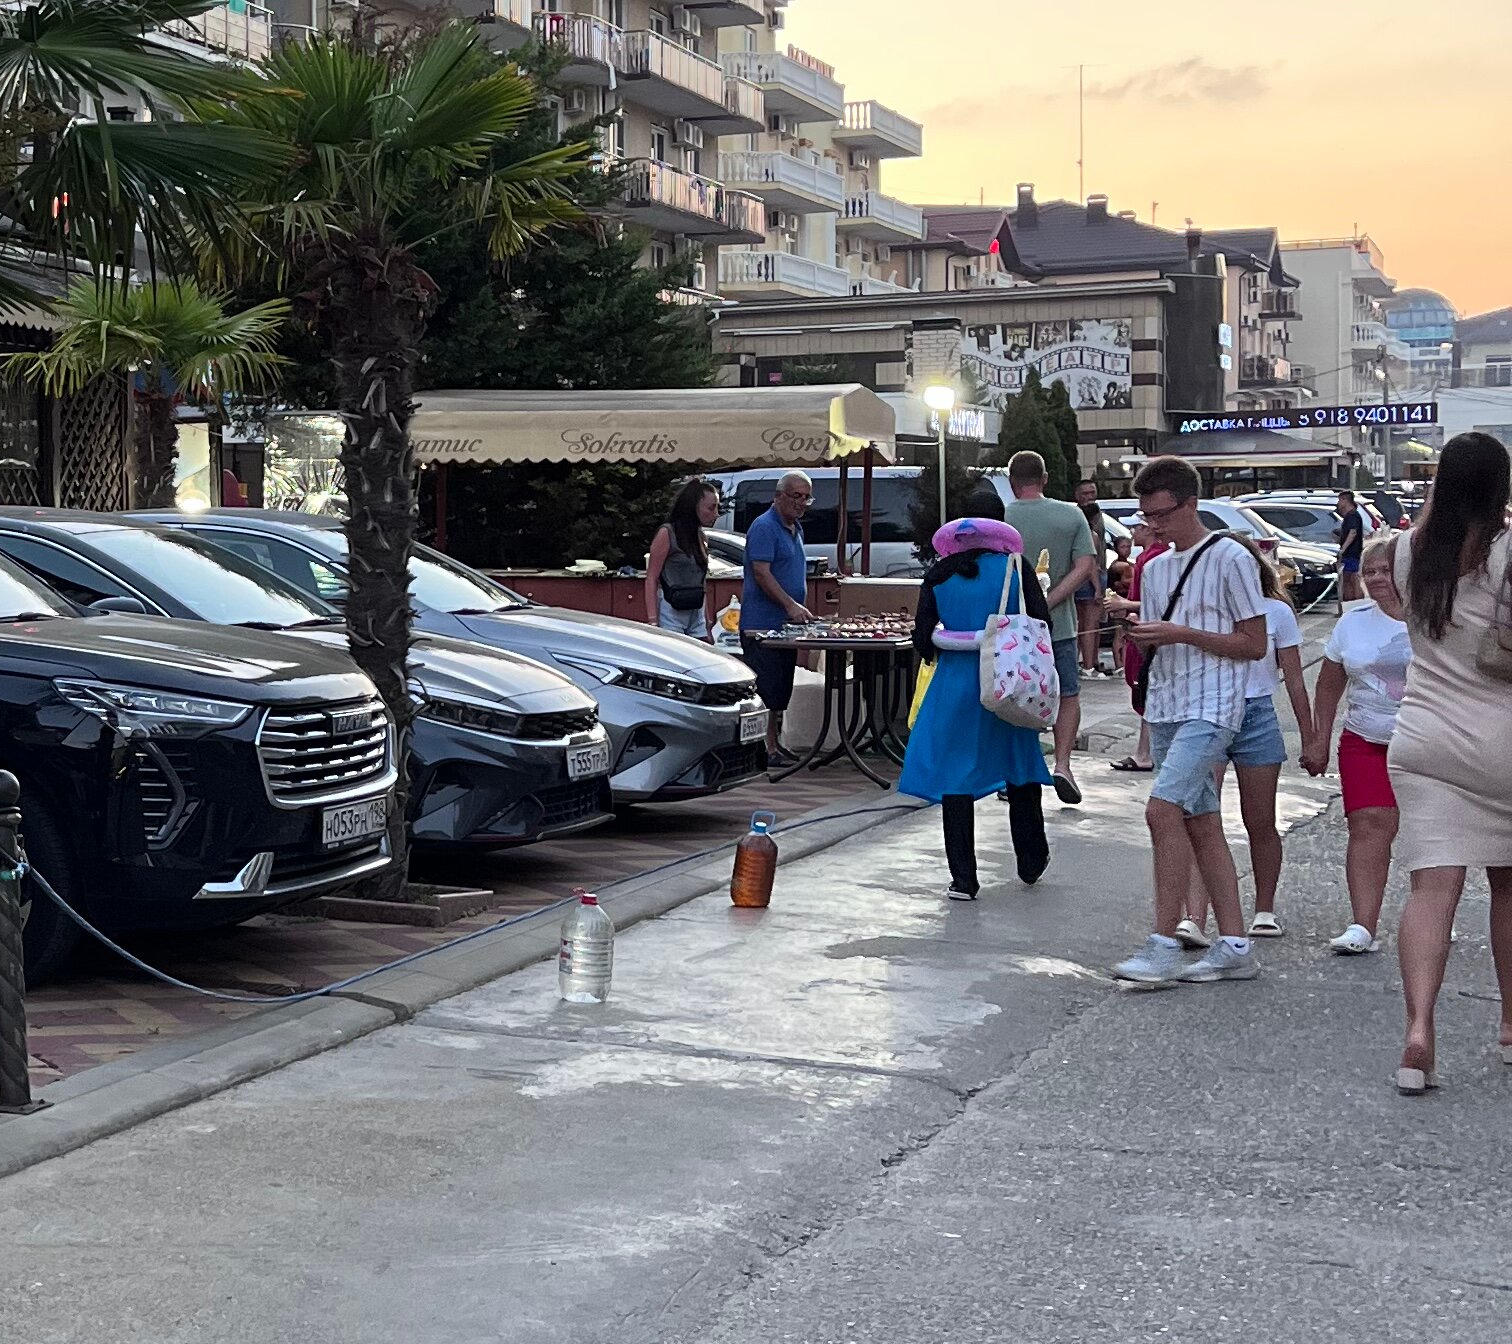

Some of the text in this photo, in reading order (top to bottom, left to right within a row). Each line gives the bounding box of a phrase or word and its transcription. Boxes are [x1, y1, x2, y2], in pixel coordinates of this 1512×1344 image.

[1180, 418, 1245, 434] ДОСТАВКА
[1314, 408, 1349, 425] 918
[1353, 404, 1432, 424] 9401141
[561, 428, 679, 454] Sokratis
